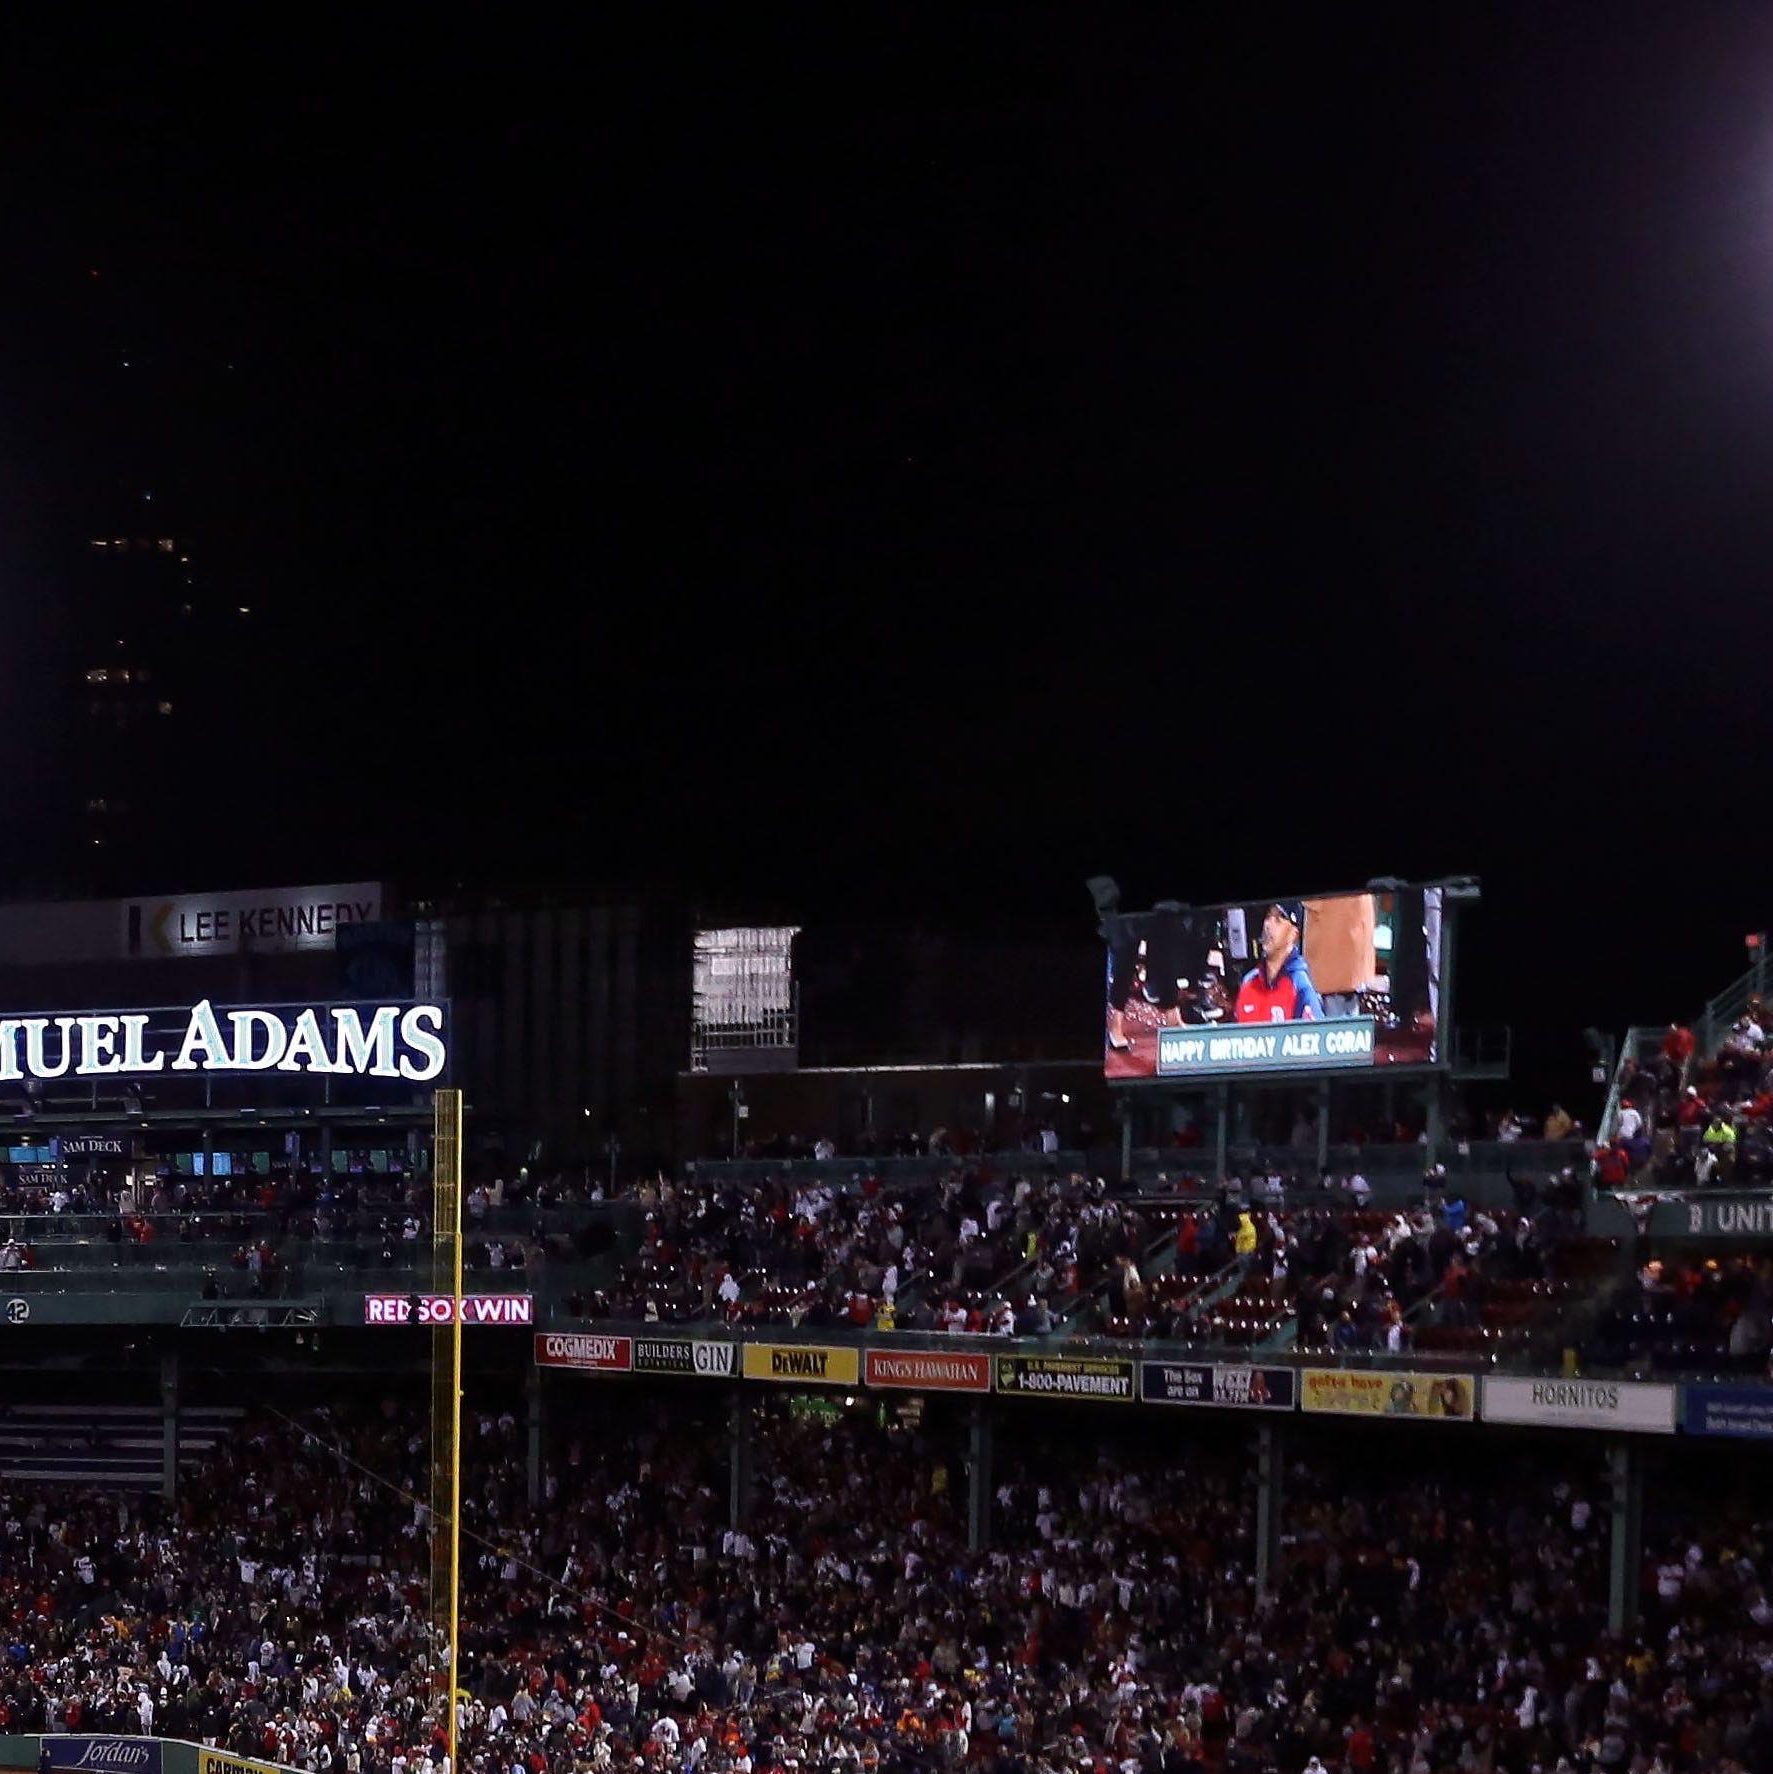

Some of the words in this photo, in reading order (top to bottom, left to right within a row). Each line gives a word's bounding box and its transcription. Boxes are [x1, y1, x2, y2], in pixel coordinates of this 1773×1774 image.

[180, 911, 230, 942] LEE
[172, 999, 447, 1081] ADAMS
[1161, 1040, 1205, 1063] HAPPY
[1210, 1035, 1276, 1060] BIRTHDAY
[1282, 1033, 1320, 1056] ALEX
[1326, 1030, 1371, 1053] CORA!
[88, 1140, 122, 1153] DECK
[7, 1302, 28, 1320] 42
[369, 1299, 412, 1321] RED
[474, 1299, 529, 1321] WIN
[546, 1337, 616, 1360] COGMEDIX
[638, 1343, 690, 1360] BUILDERS
[695, 1344, 729, 1371] GIN
[1018, 1372, 1129, 1396] 1-800-PAVEMENT
[1532, 1383, 1618, 1409] HORNITOS
[76, 1740, 149, 1767] Jordan's
